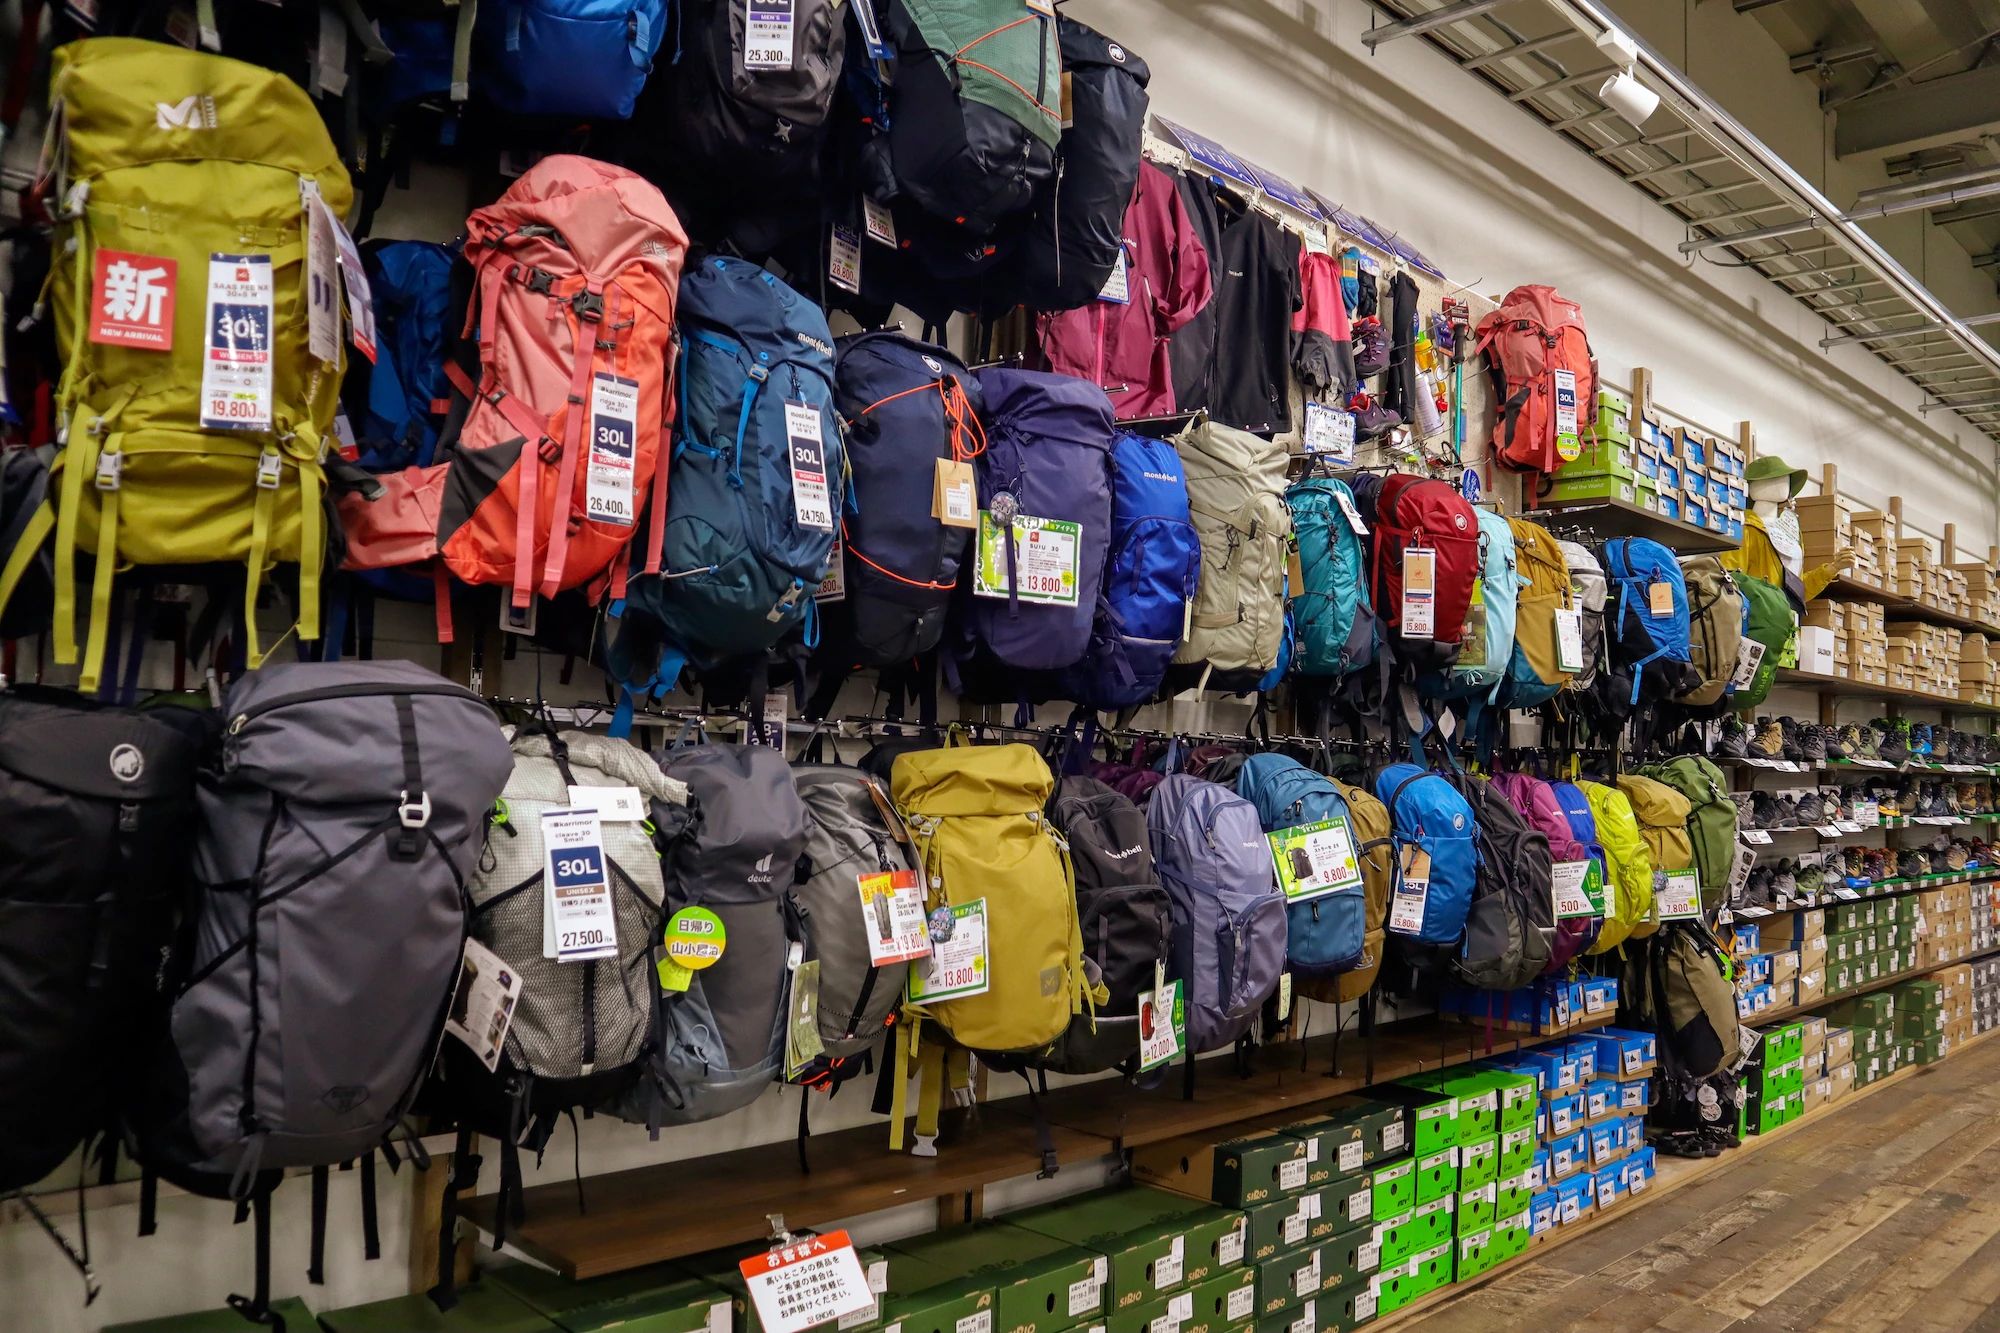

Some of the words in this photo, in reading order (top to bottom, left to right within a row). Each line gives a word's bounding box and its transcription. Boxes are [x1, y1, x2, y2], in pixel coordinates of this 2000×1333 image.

[748, 49, 783, 62] 25,300
[832, 262, 854, 282] 28,800
[103, 260, 169, 325] 新
[100, 327, 122, 337] NEW
[124, 330, 164, 342] ARRIVAL
[217, 317, 265, 339] 30L
[1559, 393, 1574, 403] 30L
[211, 400, 257, 418] 19,800
[598, 426, 630, 449] 30L
[795, 446, 820, 466] 30L
[590, 496, 623, 515] 26,400
[800, 508, 826, 524] 24,750
[1028, 575, 1060, 592] 13,800
[1406, 622, 1427, 632] 15,800
[557, 858, 599, 877] 30L
[1323, 866, 1347, 883] 9,800
[566, 887, 595, 896] UNISEX
[1666, 903, 1689, 914] 7,800
[679, 918, 714, 934] 日帰り
[1394, 917, 1416, 929] 15,800
[562, 929, 603, 947] 27,500
[944, 966, 973, 987] 13,800
[1150, 1038, 1170, 1060] 12,000
[766, 1240, 827, 1268] お客様へ
[765, 1255, 840, 1286] 高いところの商品を
[778, 1278, 846, 1308] 係員までお気軽に
[780, 1290, 852, 1319] お声掛けください。
